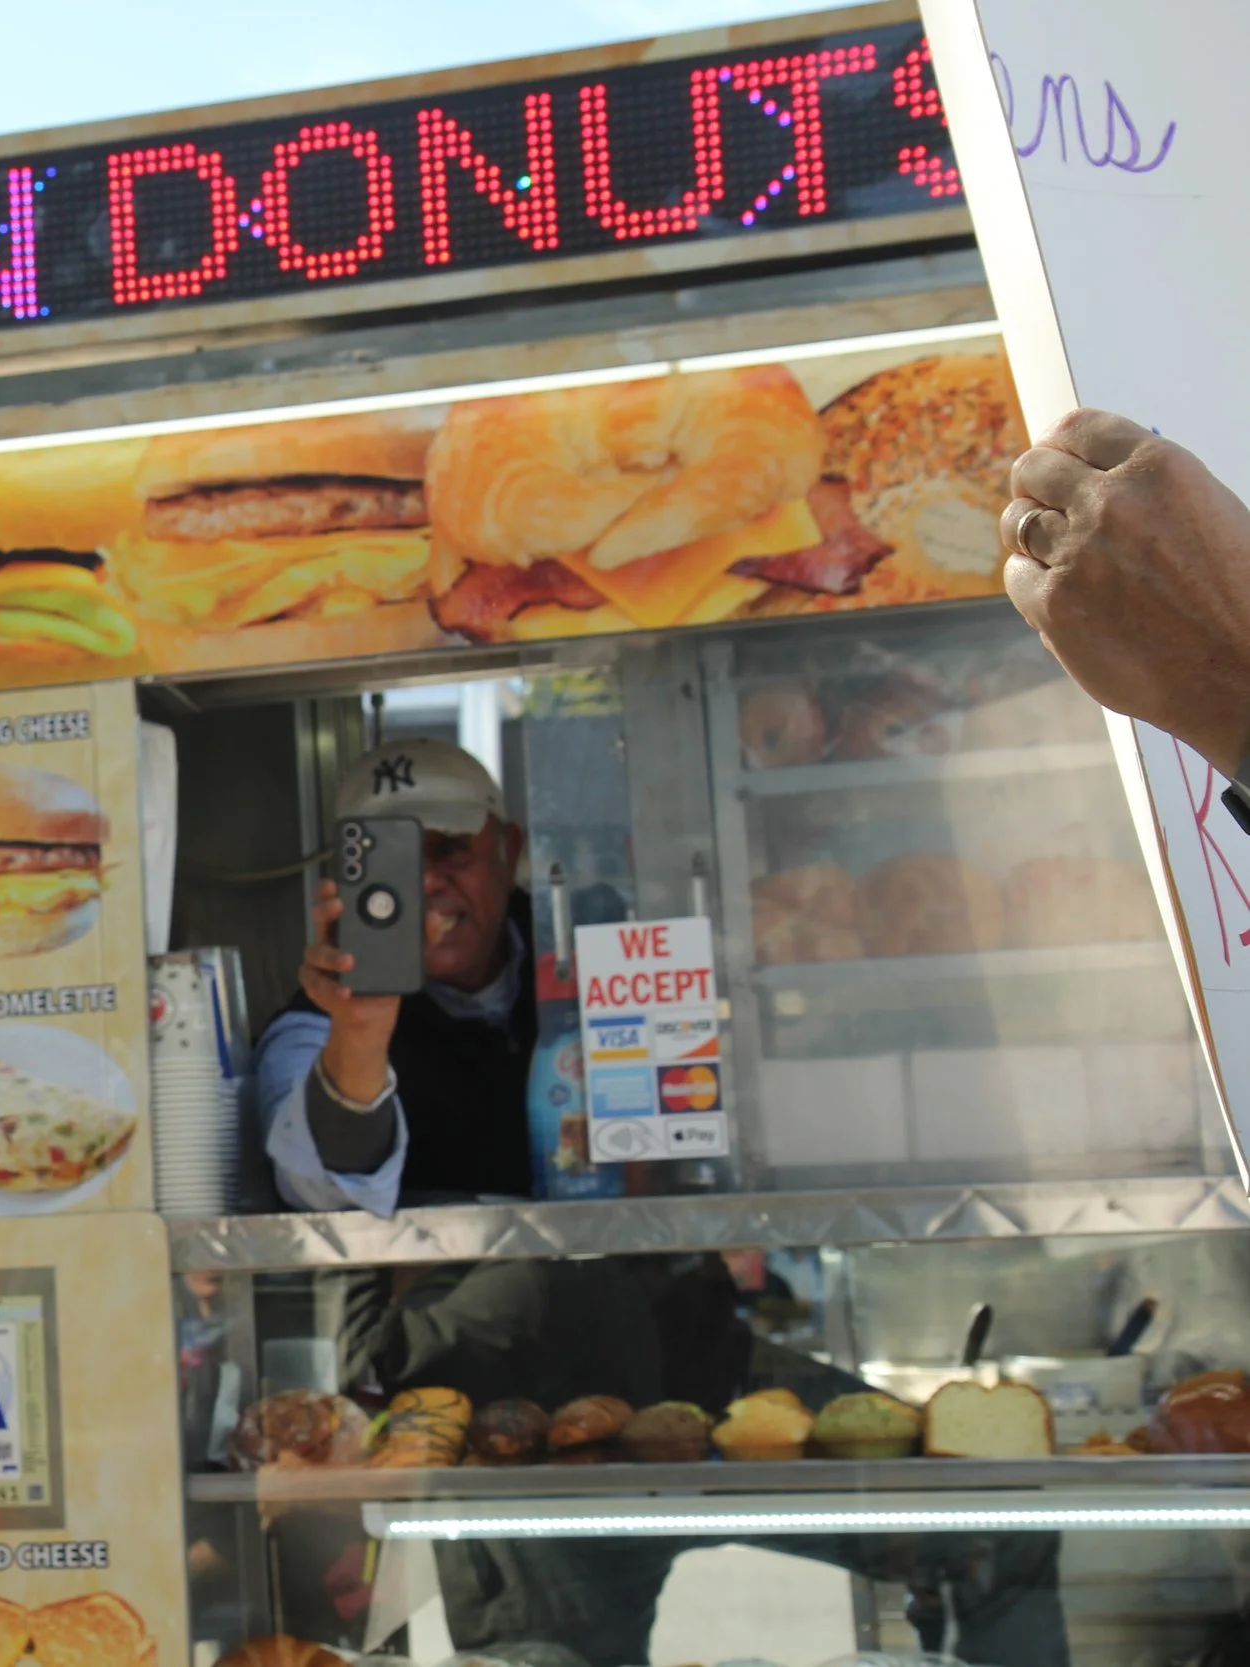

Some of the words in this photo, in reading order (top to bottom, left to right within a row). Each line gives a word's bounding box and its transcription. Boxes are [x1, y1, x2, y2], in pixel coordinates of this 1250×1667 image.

[16, 711, 91, 742] CHEESE
[618, 925, 671, 961] WE
[585, 967, 713, 1010] ACCEPT
[598, 1027, 640, 1048] VISA
[16, 1541, 109, 1570] CHEESE
